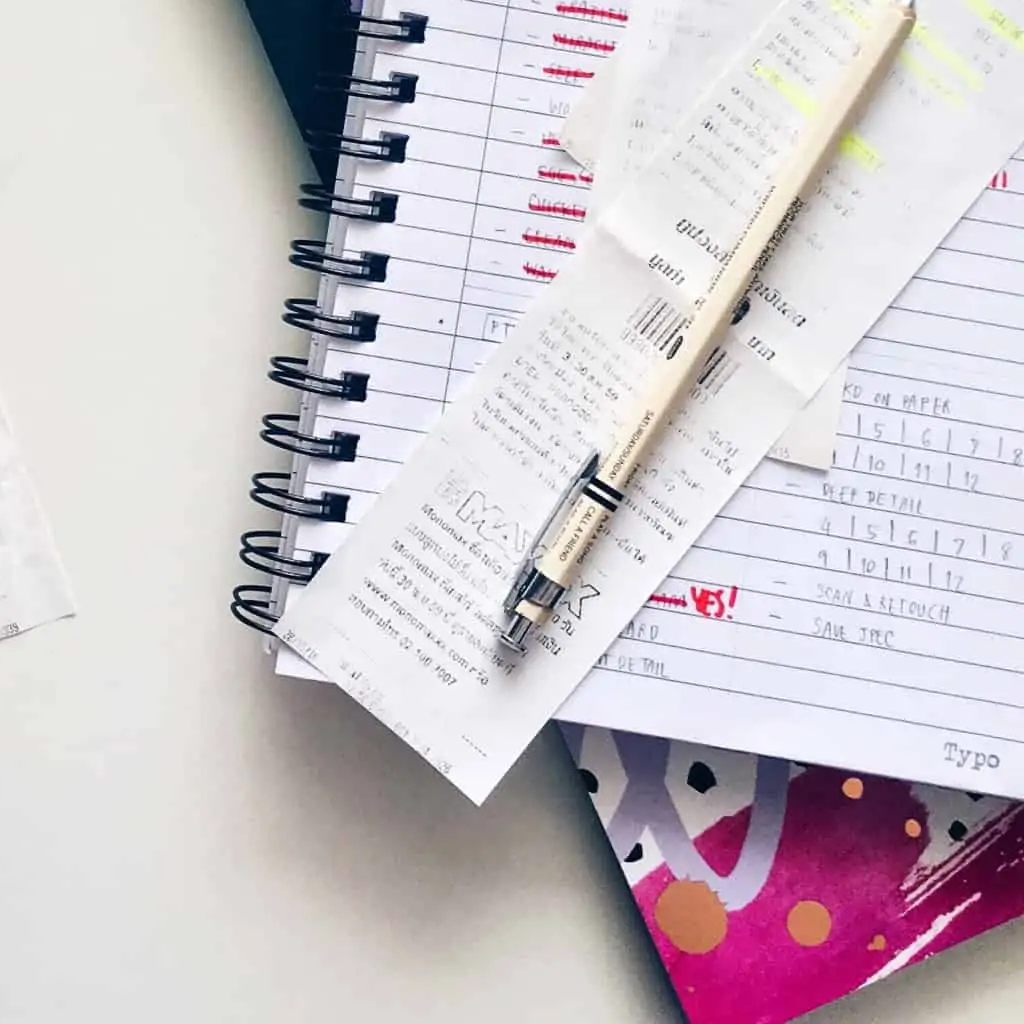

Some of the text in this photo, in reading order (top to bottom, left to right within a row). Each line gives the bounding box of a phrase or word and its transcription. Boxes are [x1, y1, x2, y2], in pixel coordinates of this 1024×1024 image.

[902, 393, 953, 415] PAPER
[606, 407, 655, 482] SATURDAY/SUNDAY
[578, 503, 597, 527] CALL
[868, 490, 924, 515] DETAIL
[557, 531, 580, 563] FRIEND
[690, 585, 738, 619] YES!
[817, 582, 852, 606] SCAN
[879, 595, 951, 624] RETOUCH
[813, 617, 847, 640] SAVE
[618, 655, 669, 678] DETAIL
[944, 742, 1002, 771] Typo
